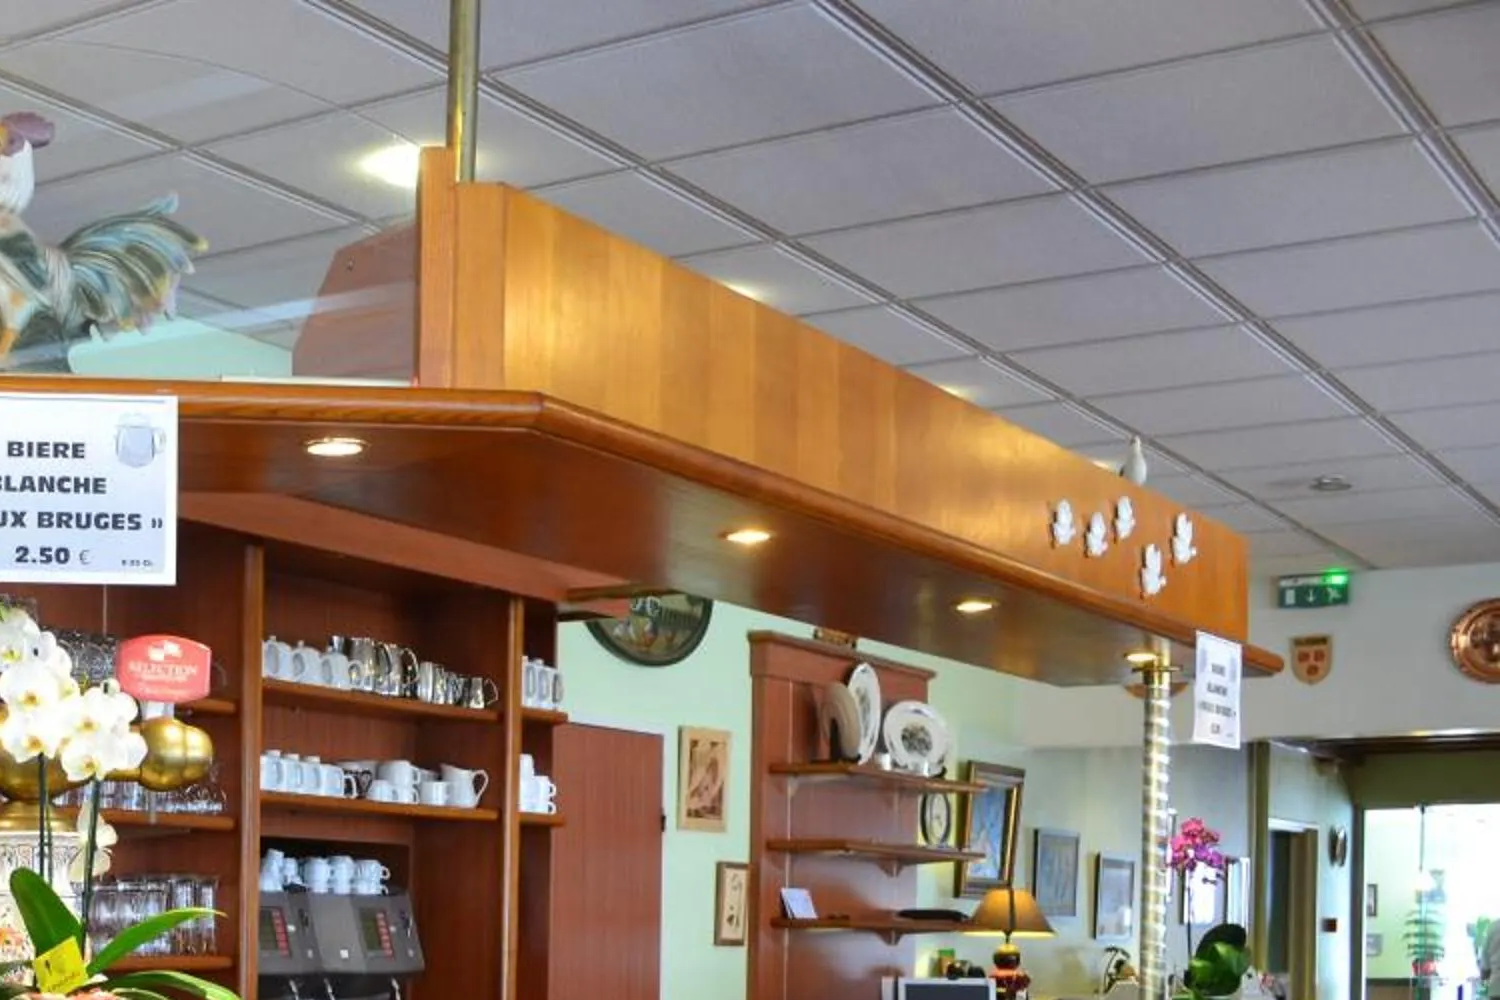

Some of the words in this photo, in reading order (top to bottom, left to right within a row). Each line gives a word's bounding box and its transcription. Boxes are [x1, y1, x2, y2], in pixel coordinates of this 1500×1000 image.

[7, 441, 86, 459] BIERE
[37, 511, 142, 530] BRUGES
[14, 546, 71, 565] 2.50
